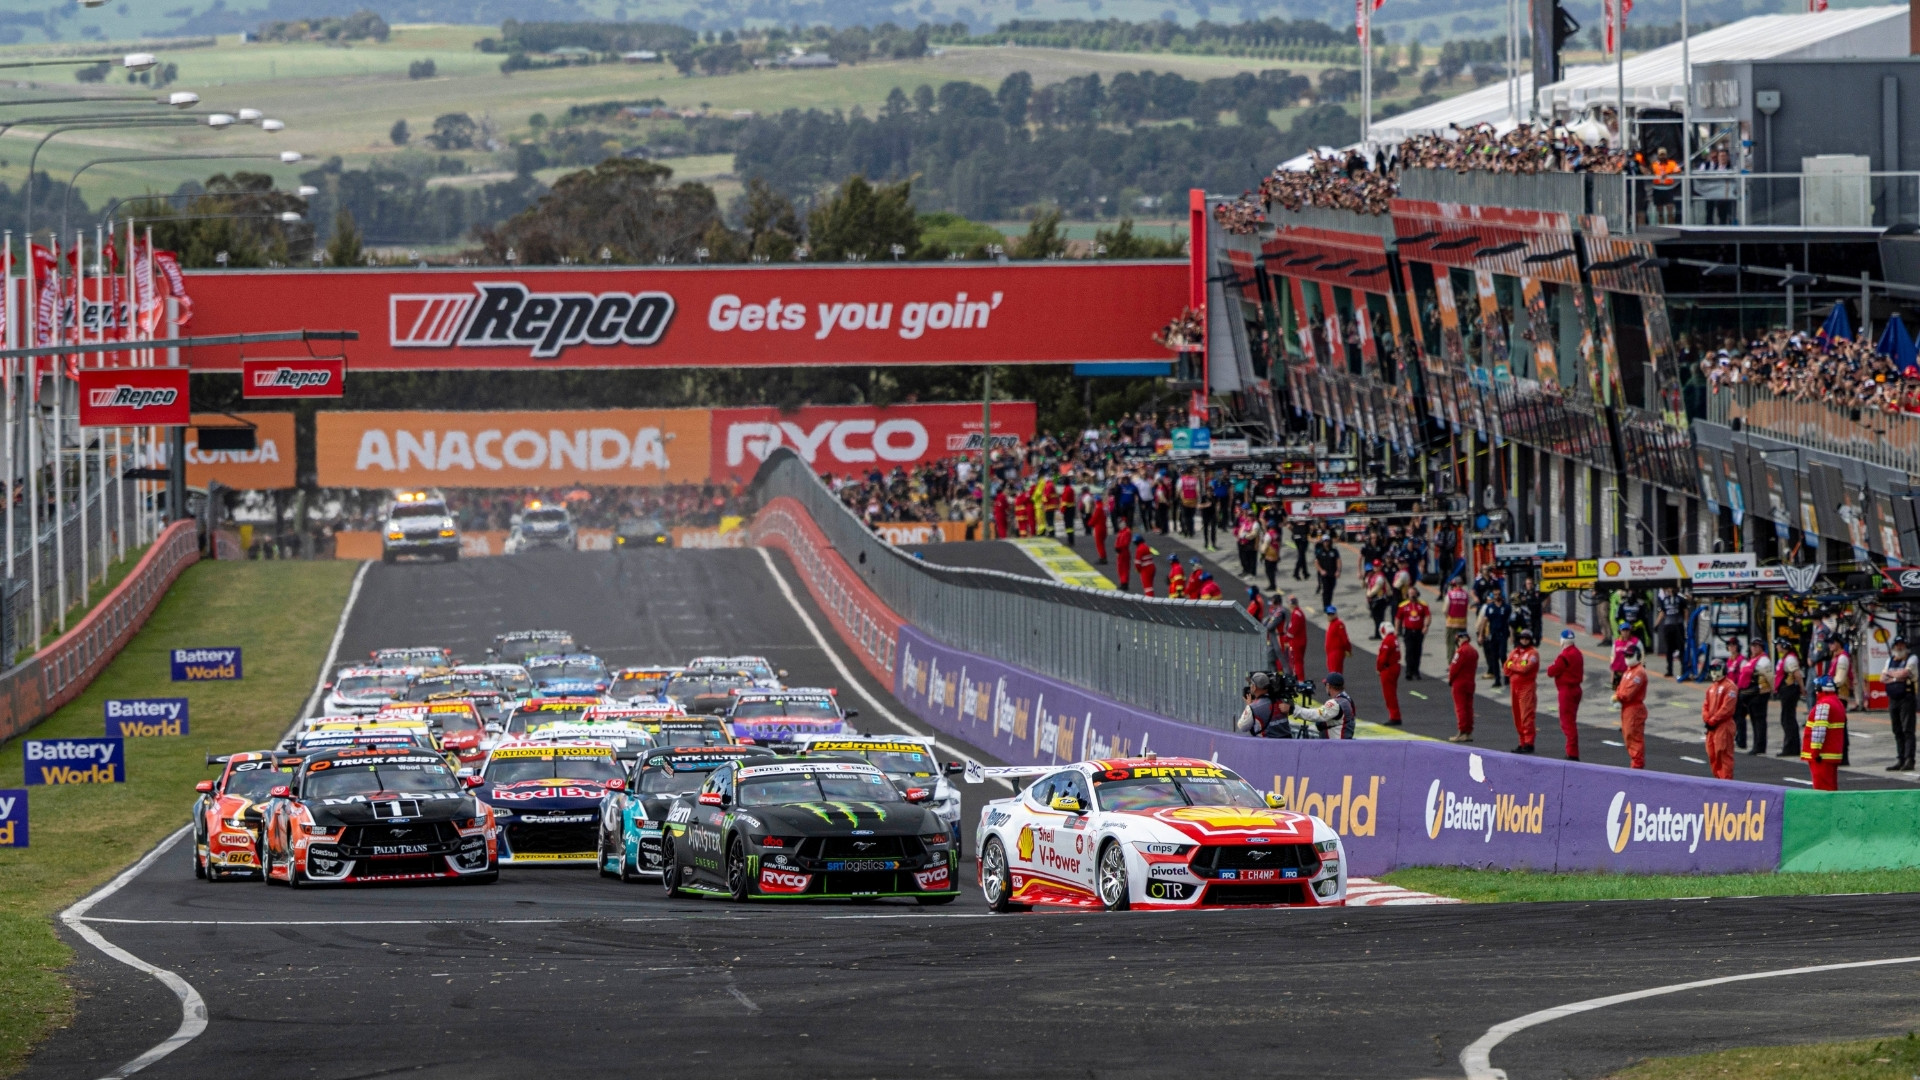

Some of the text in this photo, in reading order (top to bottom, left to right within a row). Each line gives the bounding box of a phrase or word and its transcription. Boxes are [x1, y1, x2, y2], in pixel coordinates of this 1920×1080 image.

[458, 281, 676, 357] Repco
[708, 294, 806, 332] Gets
[815, 302, 893, 340] you
[272, 367, 331, 389] Repco
[113, 385, 178, 409] Repco
[355, 427, 670, 471] ANACONDA
[726, 418, 929, 466] RYCO
[1694, 571, 1725, 579] OPTUS
[1728, 570, 1750, 578] Mobil
[175, 649, 235, 664] Battery
[185, 664, 235, 679] World
[107, 700, 181, 719] Battery
[383, 706, 414, 715] MAKE
[431, 705, 470, 713] SUPER
[120, 719, 181, 737] World
[594, 728, 647, 738] TRUCKS
[307, 738, 353, 746] BURSON
[813, 741, 925, 753] Hydraulink
[26, 740, 115, 763] Battery
[494, 748, 552, 758] NATIONAL
[332, 756, 439, 768] TRUCK ASSIST
[753, 766, 781, 774] ENZED
[849, 765, 876, 773] ENZED
[967, 760, 981, 779] DXC
[42, 764, 115, 785] World
[1134, 767, 1228, 779] PIRTEK
[492, 786, 609, 801] Red Bu
[385, 801, 403, 817] 1
[520, 814, 593, 824] COMPLETE
[220, 835, 249, 844] CHIKO
[688, 826, 722, 856] MONSTER
[1038, 826, 1055, 843] Shell
[373, 844, 428, 855] PALM TRANS
[1152, 844, 1173, 853] mps
[695, 856, 719, 870] ENERGY
[1039, 845, 1081, 874] V-Power
[776, 864, 800, 872] TRUCKS
[1247, 870, 1275, 880] CH4MP
[762, 871, 808, 886] RYCO
[916, 869, 948, 884] RYCO
[1150, 883, 1183, 898] OTR
